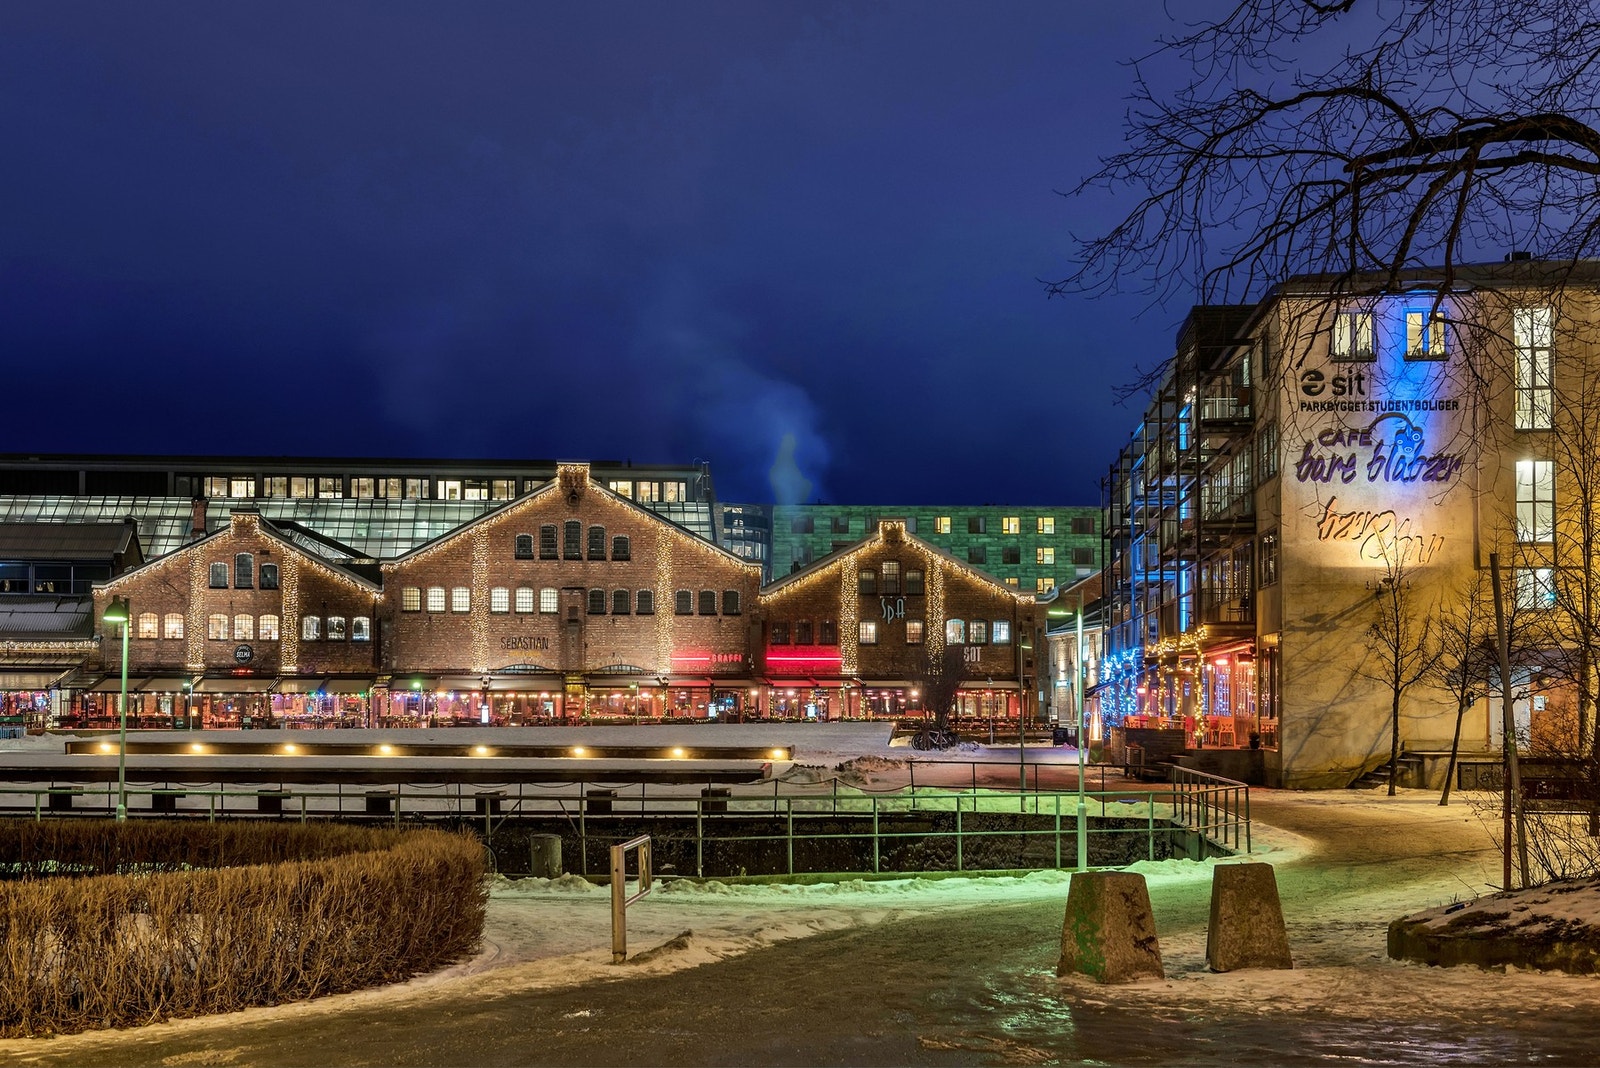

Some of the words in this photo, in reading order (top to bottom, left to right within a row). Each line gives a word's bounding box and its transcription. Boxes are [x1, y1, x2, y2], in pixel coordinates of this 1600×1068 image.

[1332, 370, 1366, 396] sit
[1300, 400, 1367, 412] PARKBYGGET
[1368, 400, 1459, 412] STUDENTBOLIGER
[1295, 439, 1357, 483] bare
[963, 646, 982, 662] SOT
